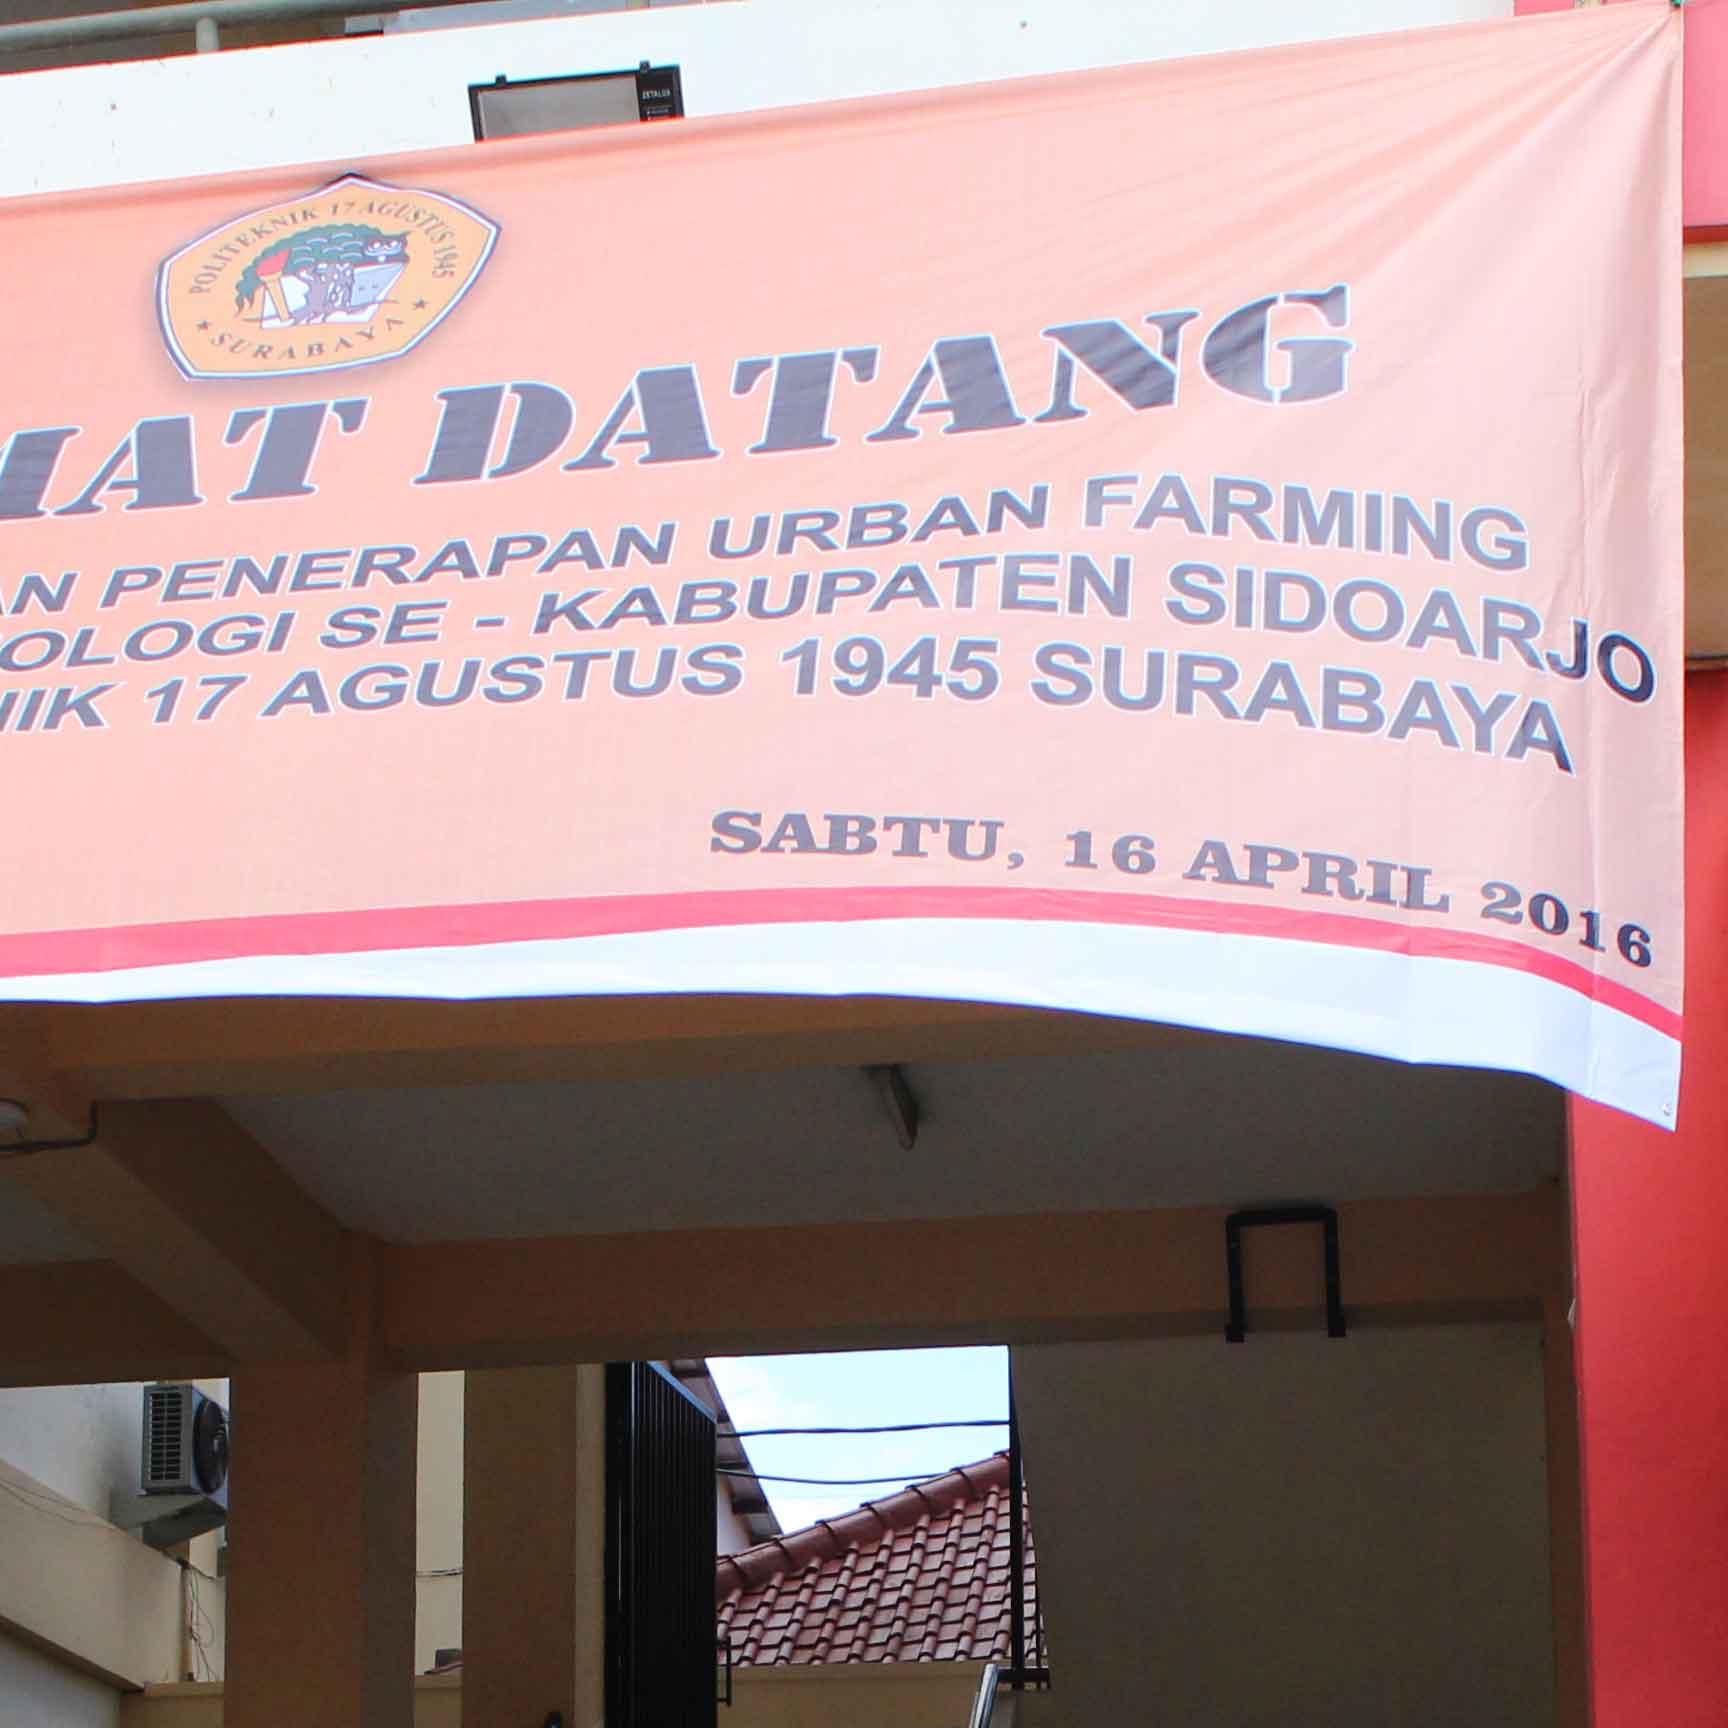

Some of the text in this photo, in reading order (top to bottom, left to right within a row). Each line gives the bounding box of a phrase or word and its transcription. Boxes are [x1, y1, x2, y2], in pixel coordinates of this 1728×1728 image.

[188, 199, 459, 294] POLITEKNIK 17 AGUSTUS 1945
[210, 317, 405, 359] SURABAYA
[413, 283, 1355, 486] DATANG
[99, 521, 677, 610] PENERAPAN
[708, 483, 1050, 562] URBAN
[1082, 471, 1530, 574] FARMING
[317, 598, 451, 652] SE
[530, 552, 1134, 640] KABUPATEN
[1163, 560, 1658, 706] SIDOARJO
[143, 671, 251, 727] 17
[257, 639, 747, 720] AGUSTUS
[780, 632, 1002, 704] 1945
[1028, 640, 1577, 778] SURABAYA
[709, 810, 1654, 970] SABTU, 16 APRIL 2016
